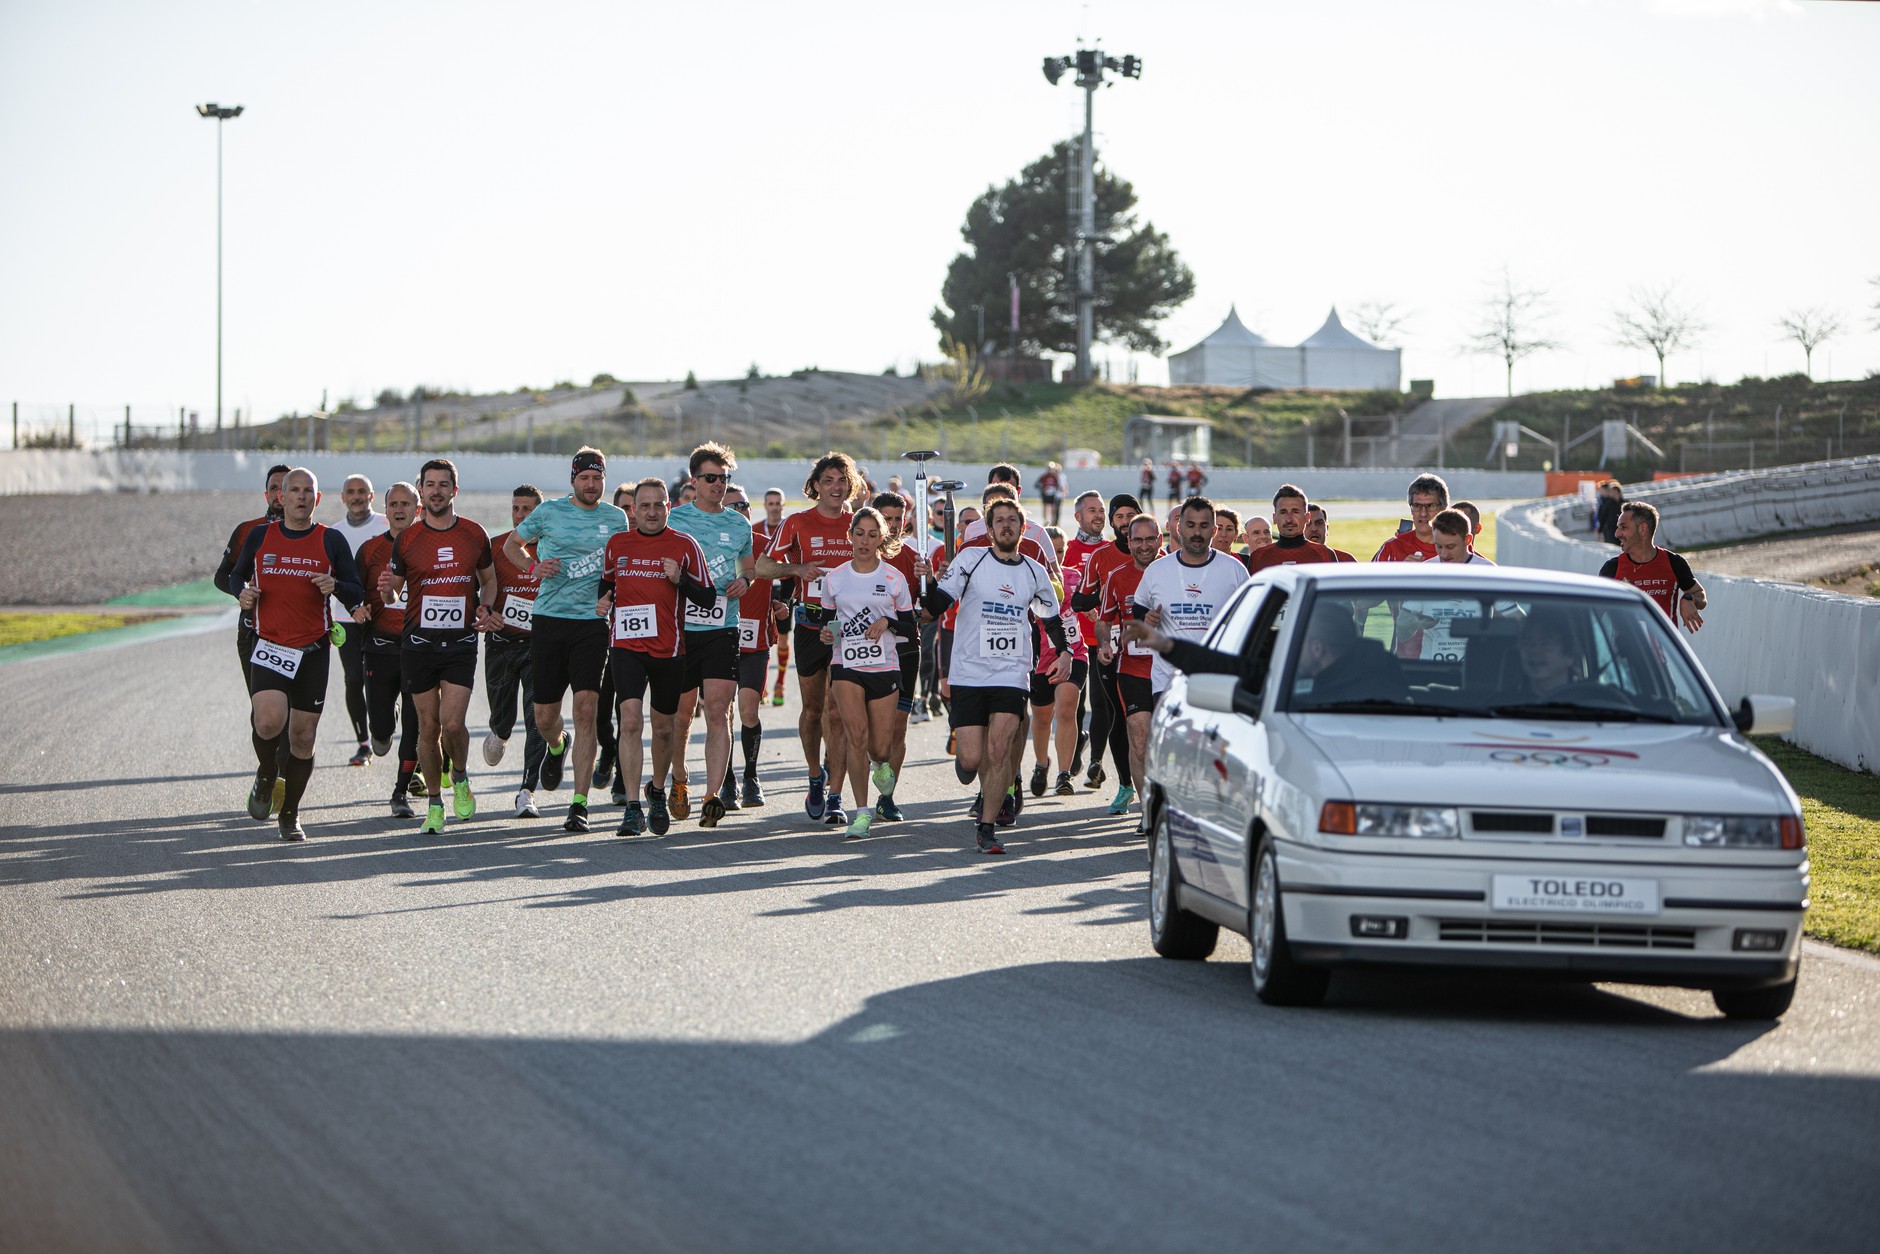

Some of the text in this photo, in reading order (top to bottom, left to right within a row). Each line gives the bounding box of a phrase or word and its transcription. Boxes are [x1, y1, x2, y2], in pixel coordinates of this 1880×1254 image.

[569, 547, 604, 571] Cursa
[812, 549, 854, 557] RUNNER
[281, 556, 321, 567] SEAT
[433, 562, 460, 570] SEAT
[262, 567, 312, 577] RUNNER
[617, 570, 667, 579] RUNNERS
[421, 575, 472, 586] RUNNERS
[424, 607, 462, 622] 070
[505, 606, 532, 624] 09
[686, 604, 724, 620] 250
[982, 600, 1024, 617] SEAT
[1170, 603, 1213, 615] SEAT
[1432, 608, 1476, 618] SEAT
[621, 617, 649, 632] 181
[843, 606, 871, 633] Cursa
[986, 637, 1017, 651] 101
[844, 645, 883, 661] 089
[255, 649, 296, 673] 098
[1529, 879, 1625, 898] TOLEDO
